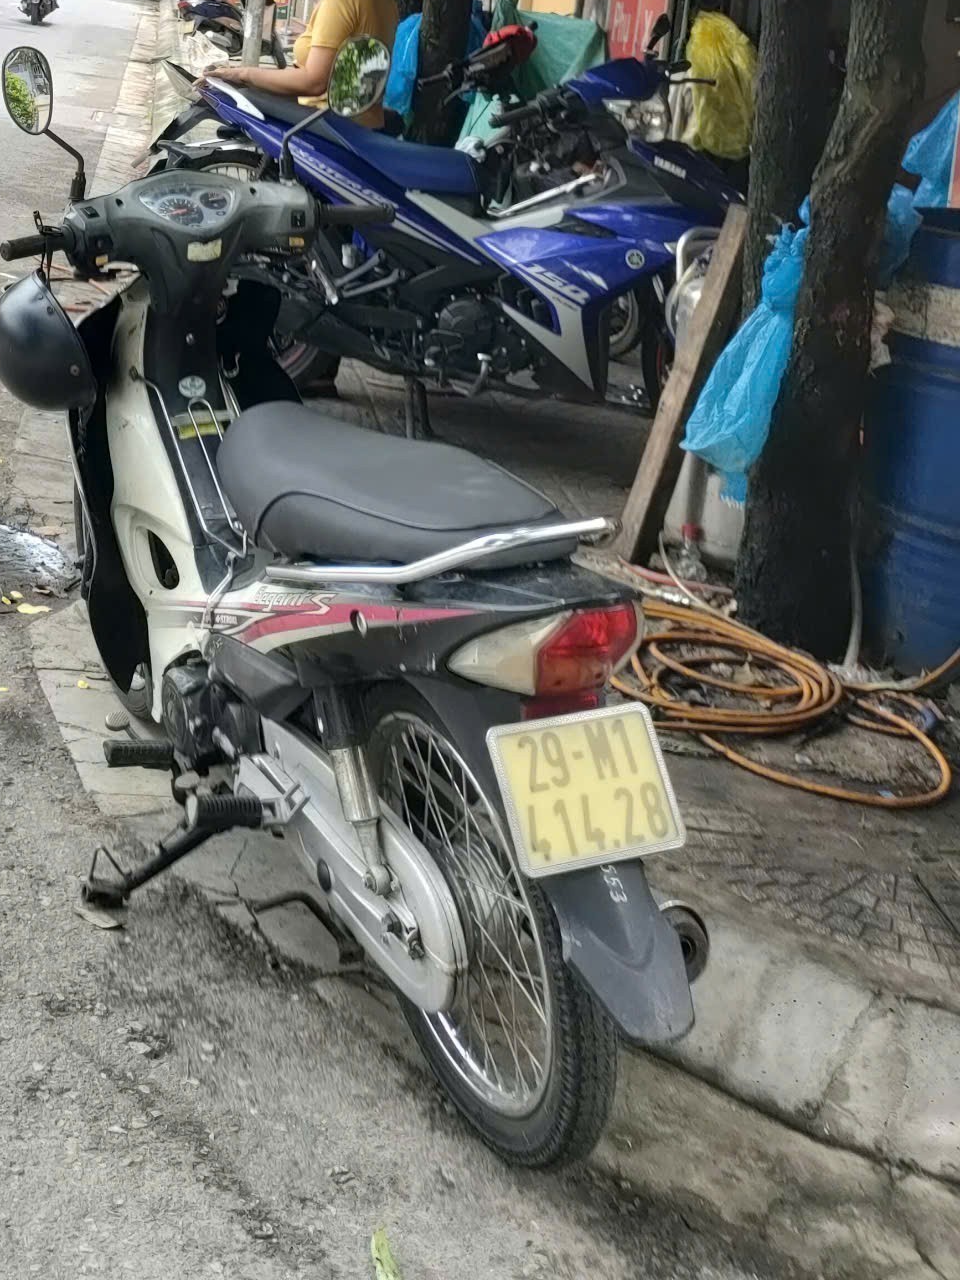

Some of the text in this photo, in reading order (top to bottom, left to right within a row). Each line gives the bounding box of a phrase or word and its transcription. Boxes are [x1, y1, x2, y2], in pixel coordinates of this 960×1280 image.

[654, 154, 687, 180] YAMAHA
[517, 718, 638, 793] 29-M1
[527, 781, 669, 862] 414.28
